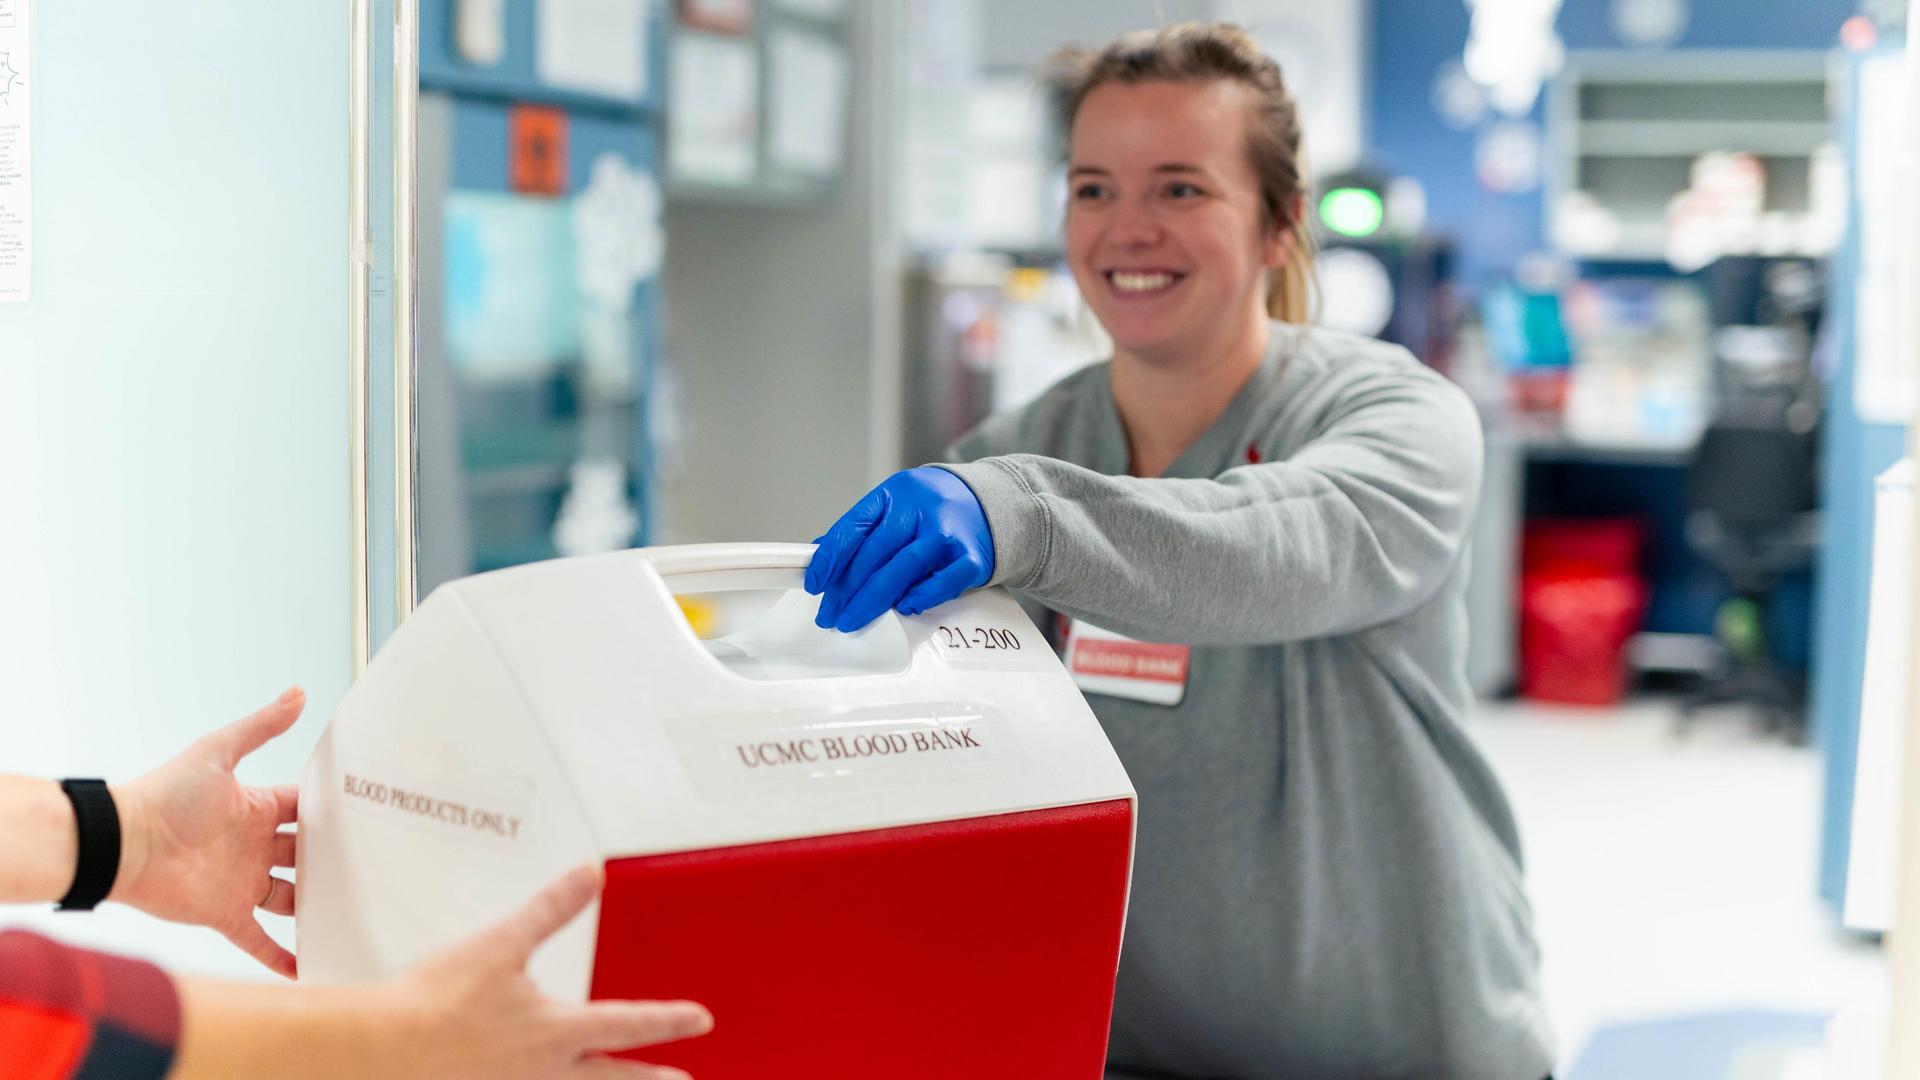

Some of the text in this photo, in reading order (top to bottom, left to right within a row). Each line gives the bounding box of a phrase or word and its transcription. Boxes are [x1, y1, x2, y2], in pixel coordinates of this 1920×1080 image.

[939, 626, 1020, 650] 21-200
[736, 728, 981, 769] UCMC BLOOD BANK
[344, 774, 524, 839] BLOOD PRODUCTS ONLY
